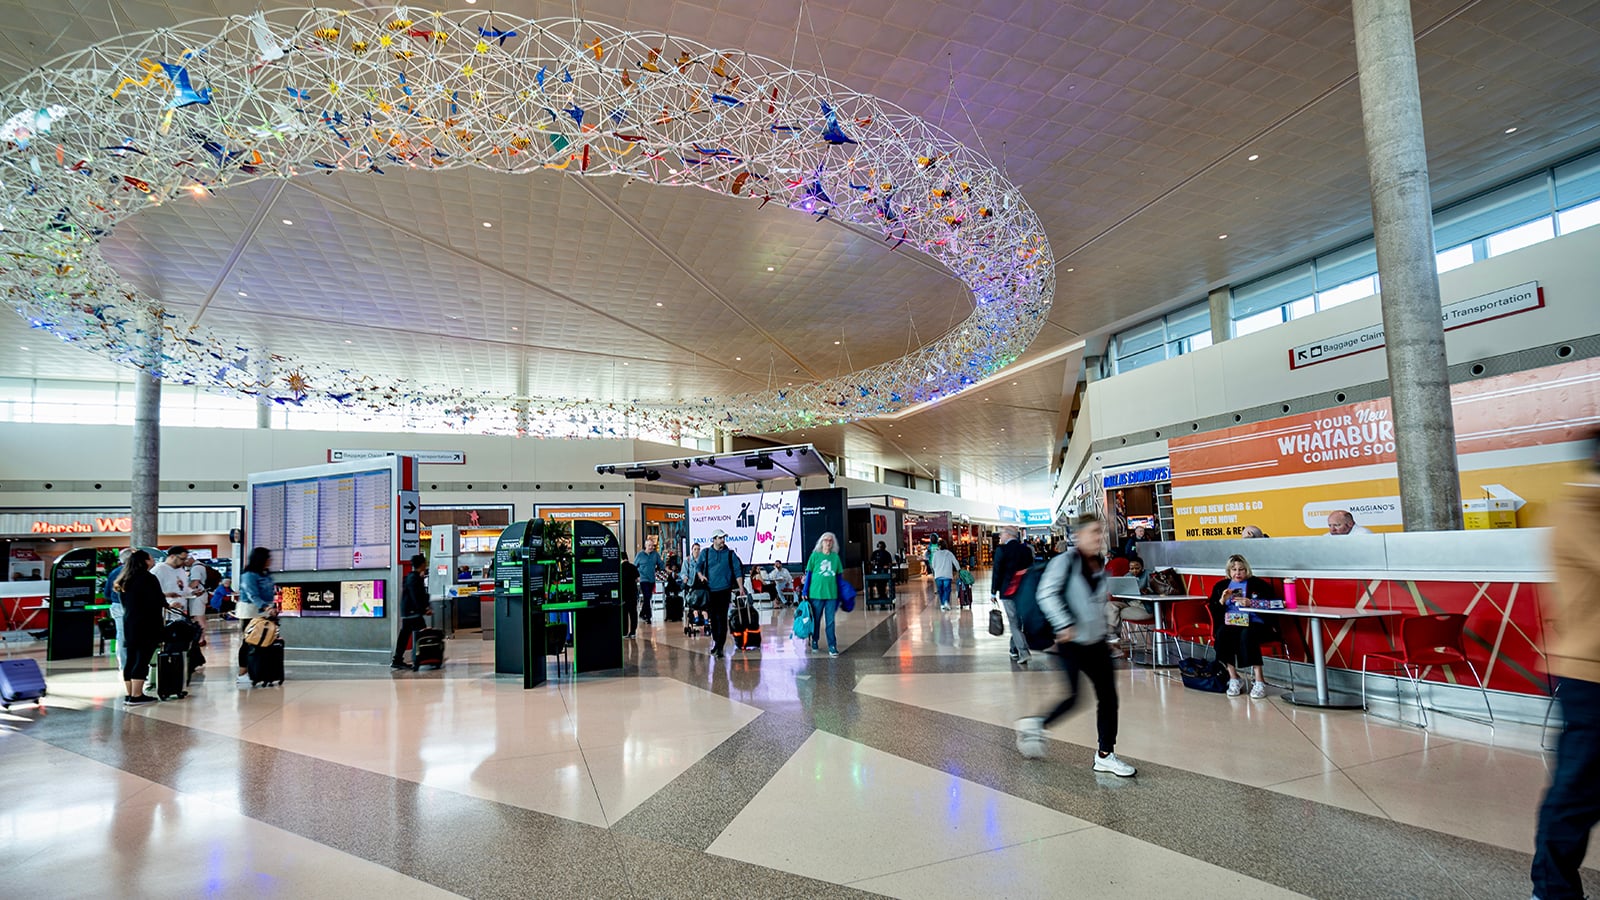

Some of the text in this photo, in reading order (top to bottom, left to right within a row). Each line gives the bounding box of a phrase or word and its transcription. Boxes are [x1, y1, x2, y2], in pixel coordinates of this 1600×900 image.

[1452, 292, 1532, 319] Transportation
[1323, 331, 1386, 354] Baggage Claim
[1314, 408, 1388, 431] YOUR New
[1277, 420, 1394, 456] WHATABUR
[1303, 446, 1360, 464] COMING
[1104, 473, 1128, 489] DALLAS
[1127, 467, 1168, 485] COWBOYS
[761, 502, 780, 510] Uber
[1176, 500, 1263, 516] VISIT OUR NEW GRAB & GO
[1350, 503, 1396, 513] MAGGIANO'S
[708, 514, 732, 522] PAVILION
[1200, 514, 1238, 525] OPEN NOW!
[1186, 528, 1201, 537] HOT.
[1202, 527, 1226, 537] FRESH.
[1226, 526, 1232, 536] &
